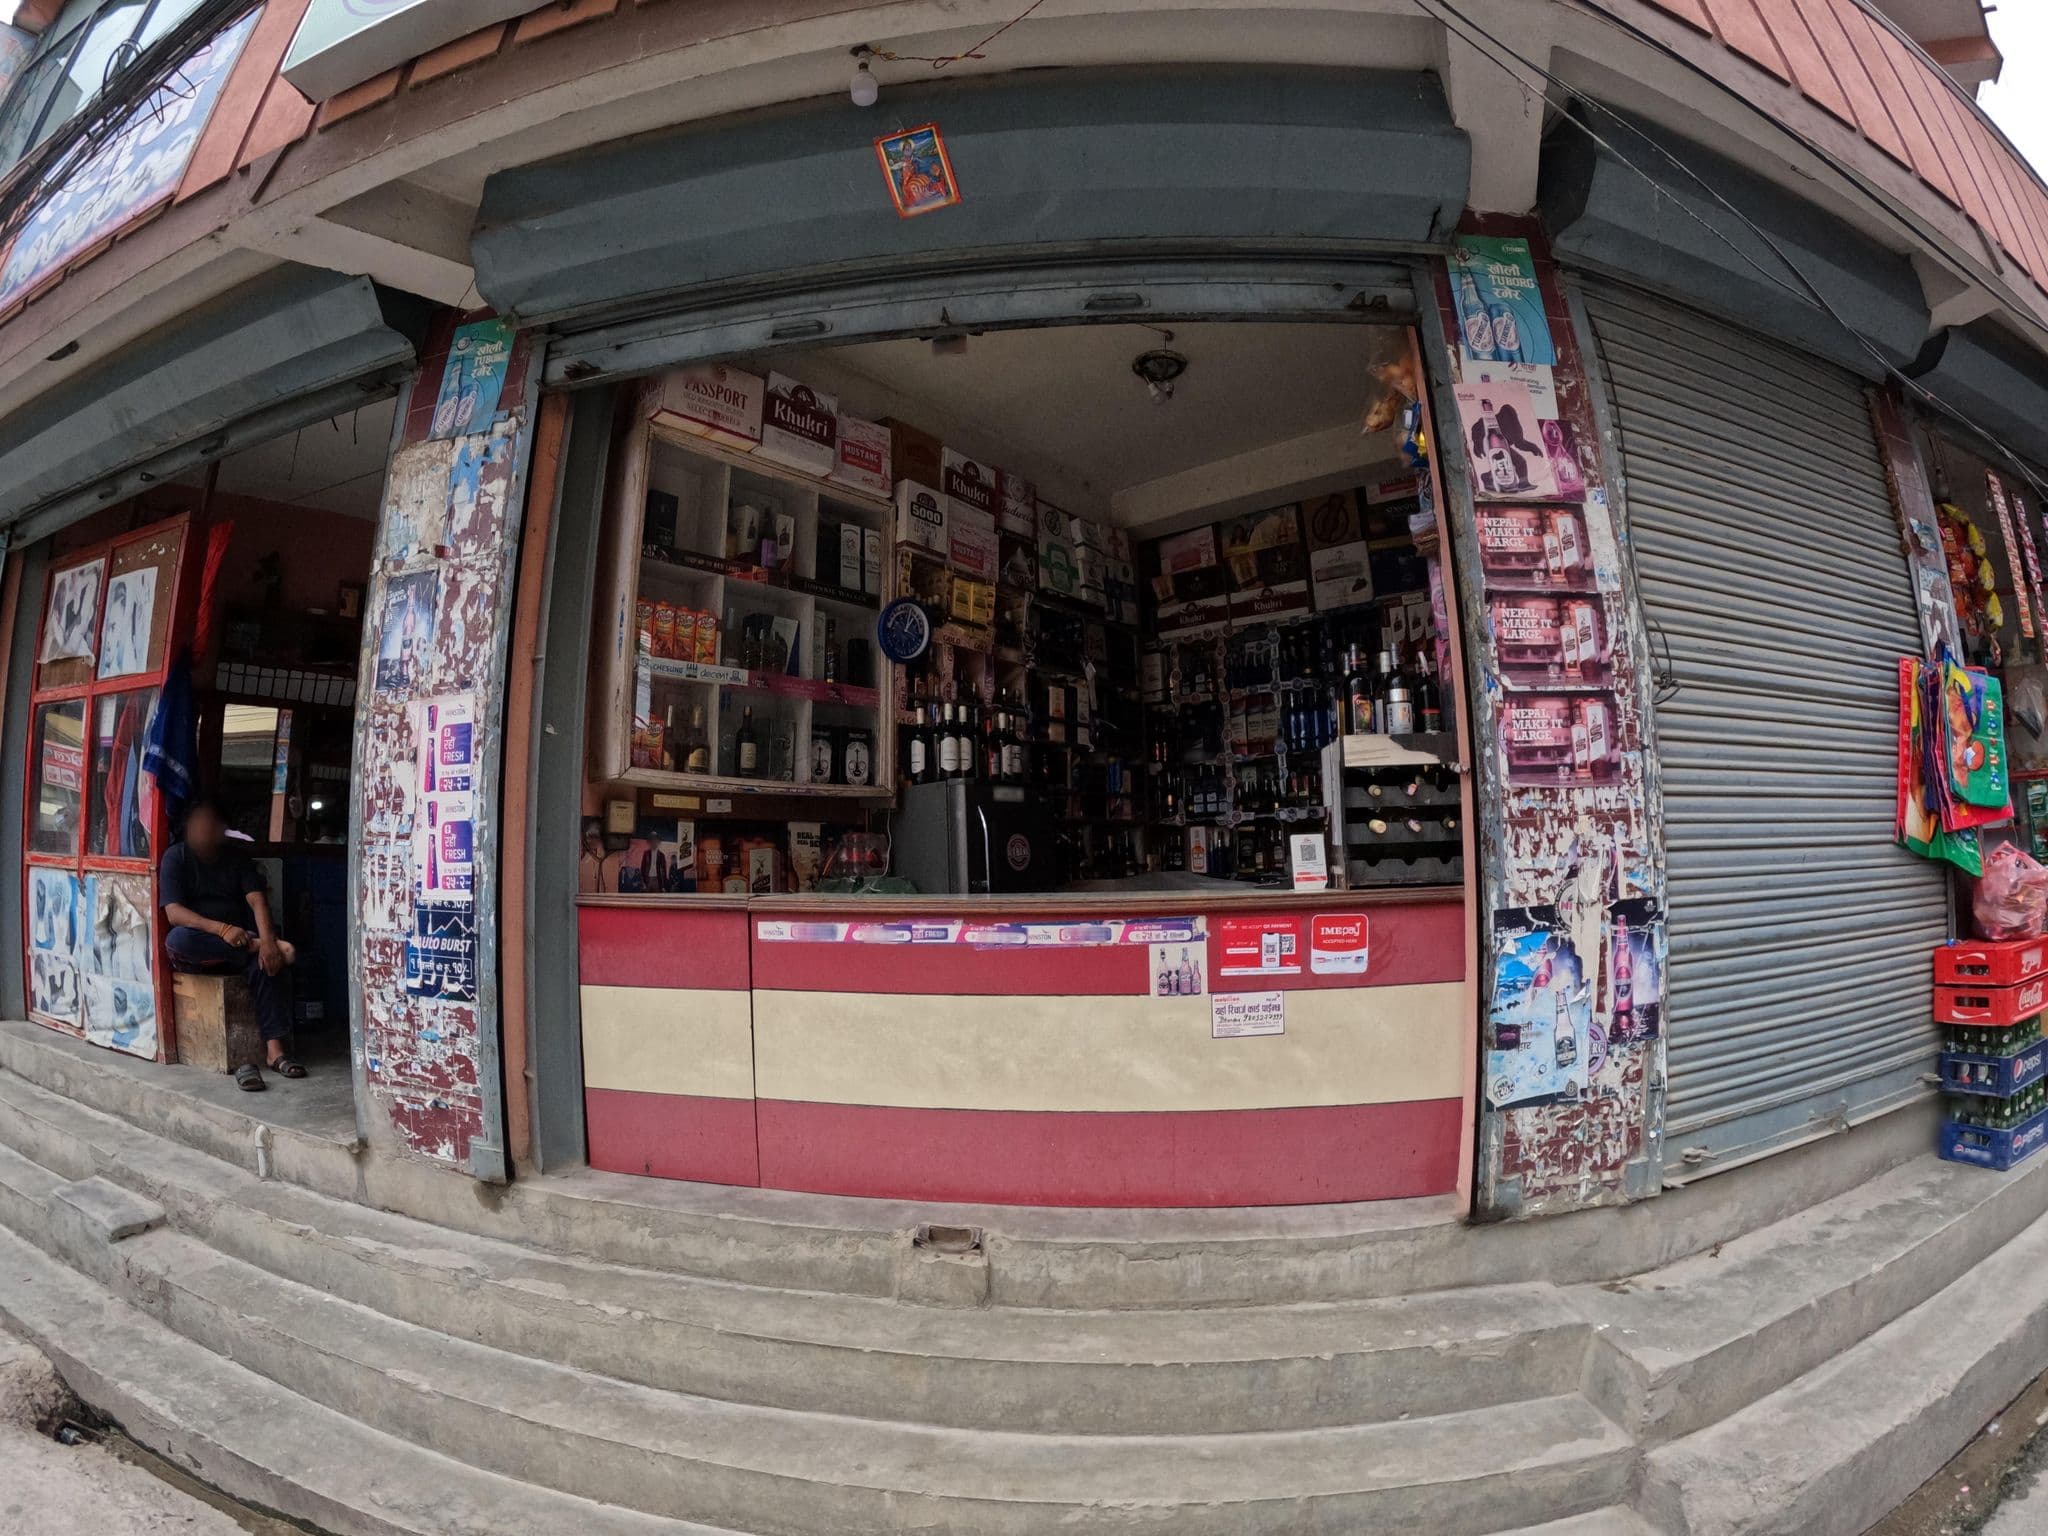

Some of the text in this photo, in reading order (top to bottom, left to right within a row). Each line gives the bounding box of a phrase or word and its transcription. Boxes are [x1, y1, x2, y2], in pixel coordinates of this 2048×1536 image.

[1489, 275, 1536, 289] TUBORG
[1471, 314, 1489, 348] TUBORG
[774, 399, 828, 437] Khukri
[845, 444, 879, 463] MUSTANG
[951, 473, 990, 505] Khukri
[912, 504, 940, 524] 5000
[1484, 528, 1535, 538] MAKE IT
[1254, 600, 1282, 611] Khukri
[1502, 618, 1552, 628] MAKE IT
[1512, 719, 1563, 730] MAKE IT
[443, 750, 465, 762] FRESH
[444, 848, 466, 860] FRESH
[440, 938, 472, 953] BURST
[2022, 1050, 2042, 1077] pepsi
